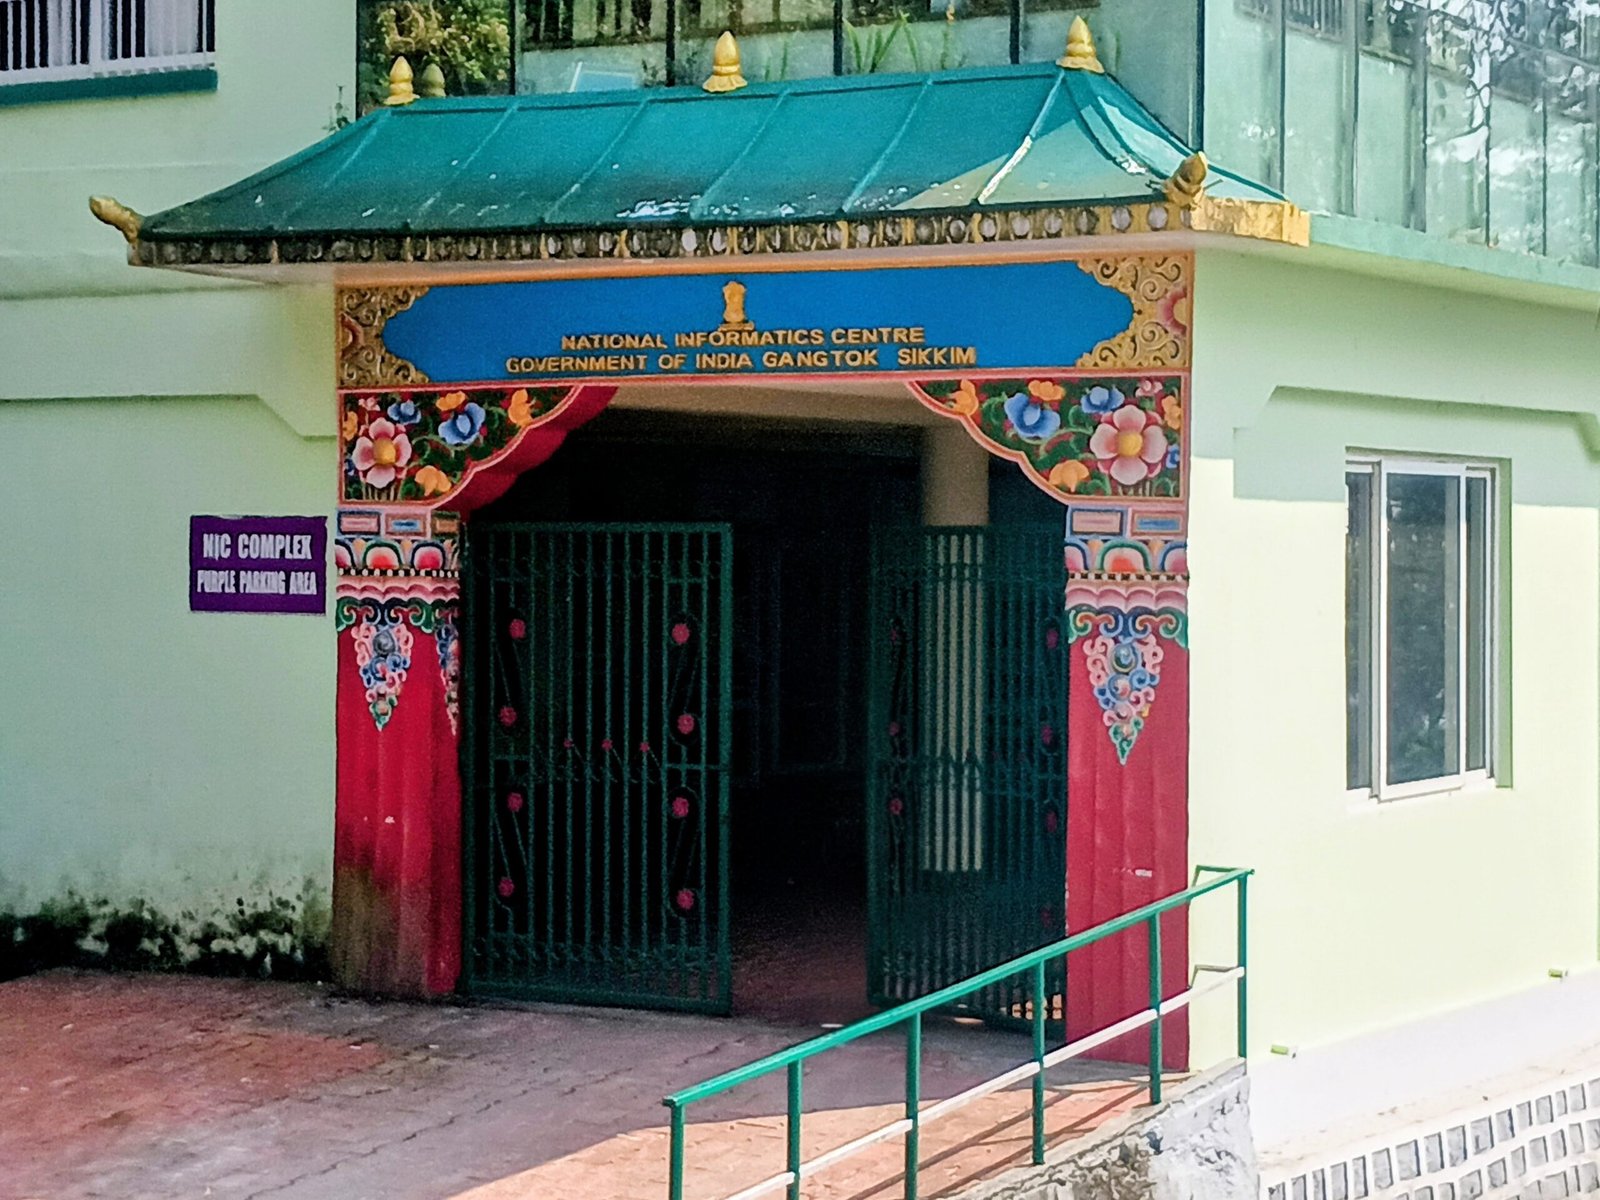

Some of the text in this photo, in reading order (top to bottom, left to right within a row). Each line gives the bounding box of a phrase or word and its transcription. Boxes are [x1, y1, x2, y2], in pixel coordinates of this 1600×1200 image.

[561, 326, 926, 350] NATIONAL INFORMATICS CENTRE
[505, 346, 977, 373] GOVERNMENT OF INDIA GANGTOK SIKKIM
[203, 533, 312, 560] NIC COMPLEX
[197, 570, 317, 595] PURPLE PARKING AREA
